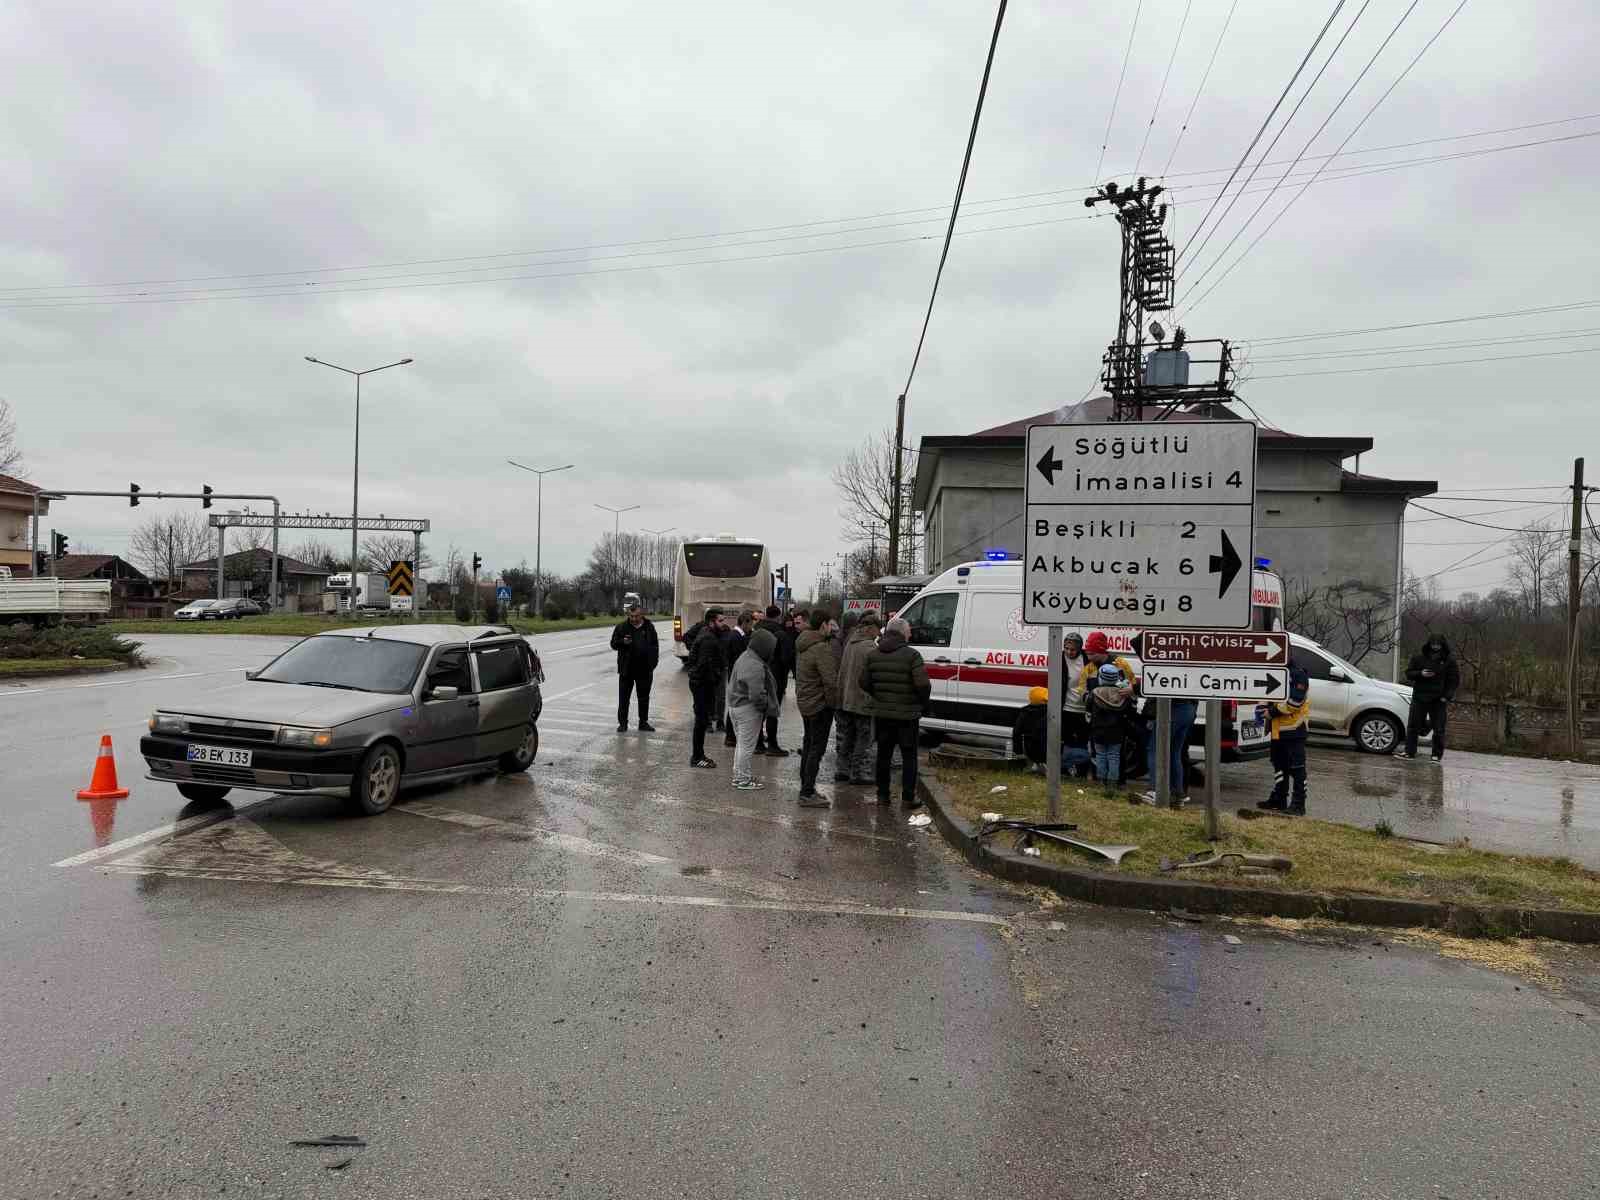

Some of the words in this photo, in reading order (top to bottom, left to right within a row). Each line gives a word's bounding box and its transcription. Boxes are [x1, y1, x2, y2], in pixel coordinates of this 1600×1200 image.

[1075, 436, 1189, 459] Söğütlü
[1076, 469, 1212, 491] İmanalisi
[1225, 470, 1242, 489] 4
[1035, 519, 1135, 540] Beşikli
[1180, 521, 1196, 539] 2
[1031, 556, 1159, 575] Akbucak
[1179, 558, 1195, 575] 6
[1032, 591, 1165, 616] Köybucağı
[1178, 595, 1193, 612] 8
[1148, 634, 1195, 646] Tarihi
[1199, 635, 1254, 648] Çivisiz
[1019, 653, 1049, 667] YAR
[1148, 647, 1190, 660] Cami
[1146, 671, 1188, 688] Yeni
[1199, 674, 1248, 691] Cami
[193, 748, 207, 760] 28
[210, 749, 224, 762] EK
[228, 751, 249, 764] 133
